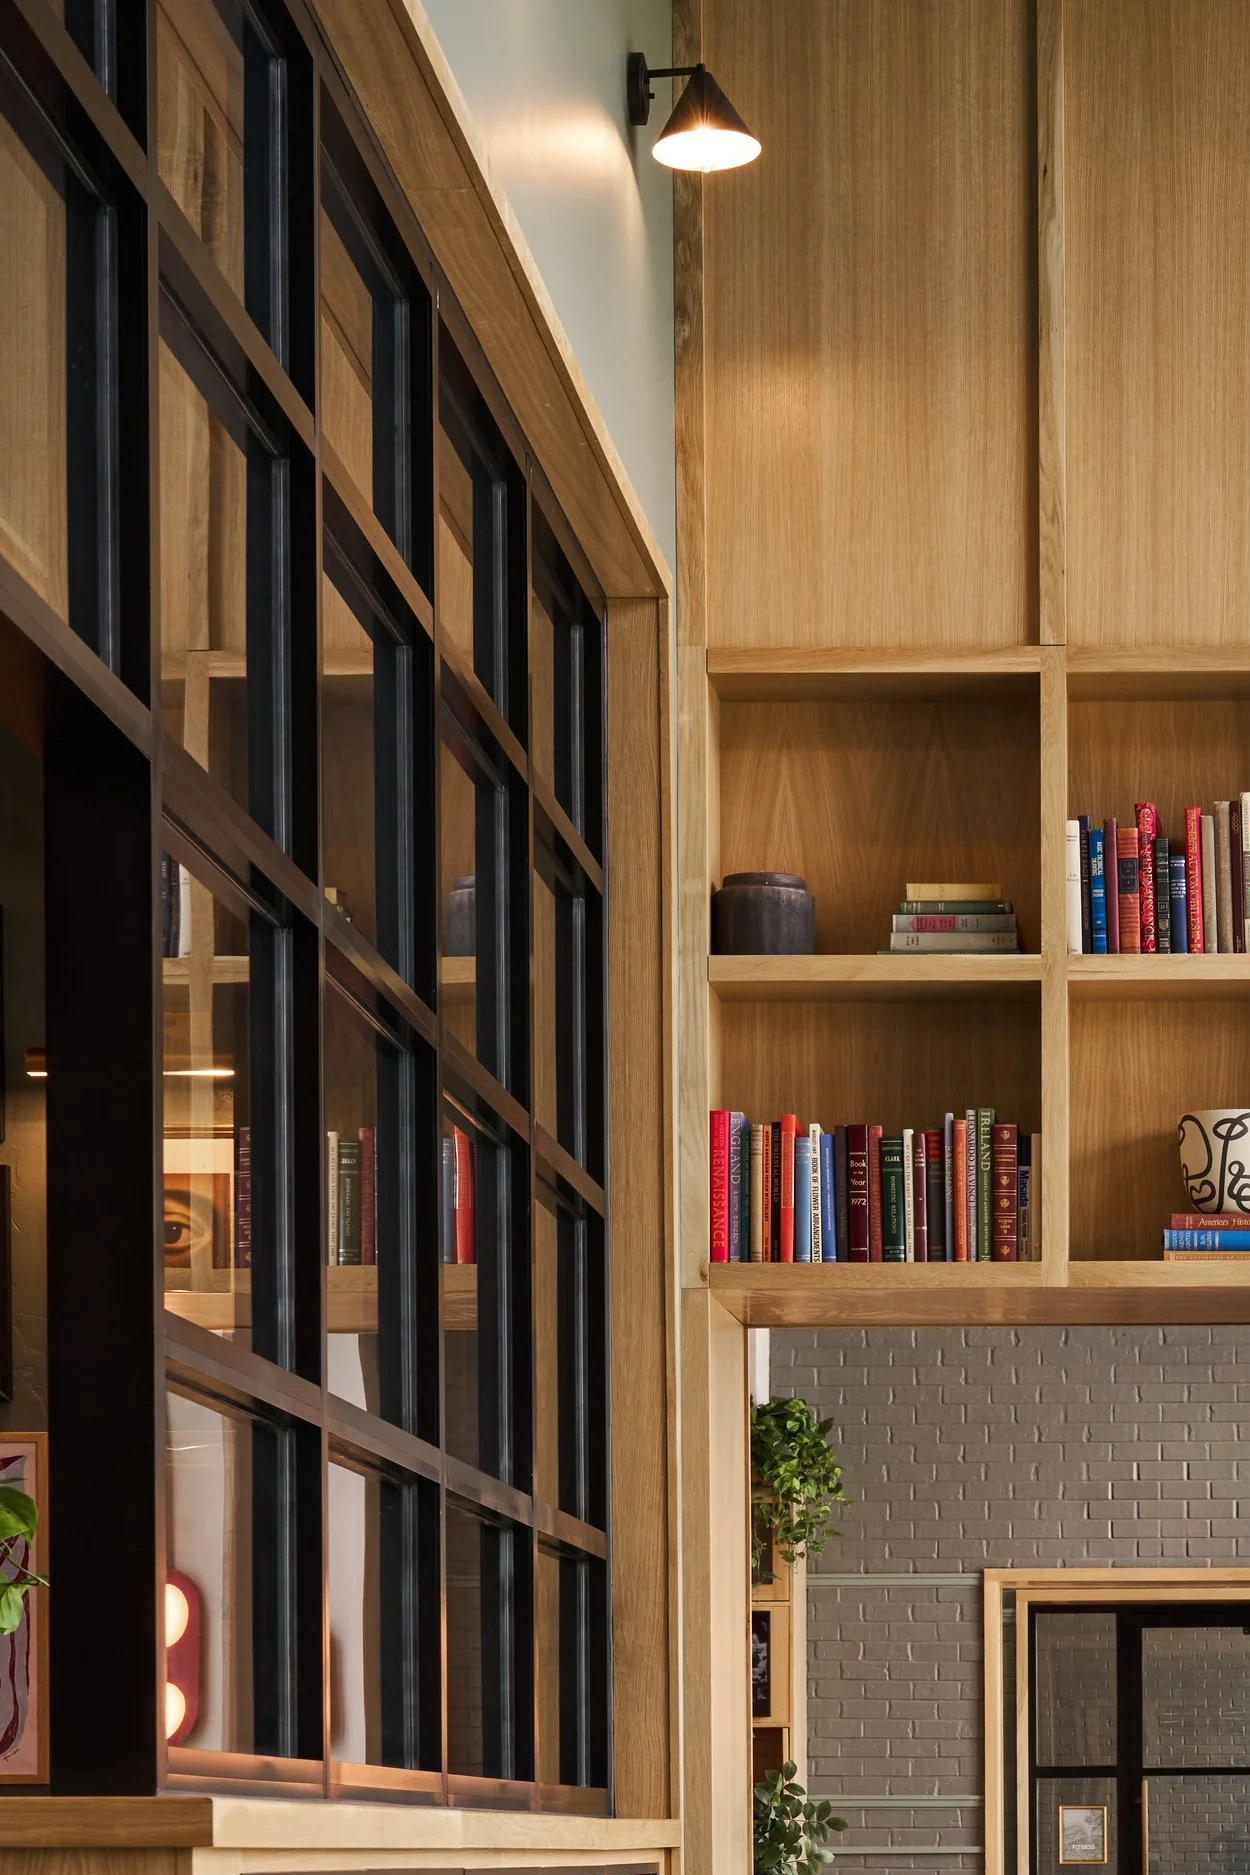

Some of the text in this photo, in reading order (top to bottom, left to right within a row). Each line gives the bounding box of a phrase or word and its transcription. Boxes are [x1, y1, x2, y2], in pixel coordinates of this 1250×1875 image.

[1144, 866, 1154, 941] RENAISSANCE
[1188, 853, 1201, 931] AUTOMOBILES
[730, 1117, 740, 1184] ENGLAND
[968, 1165, 975, 1180] DA
[980, 1111, 990, 1171] IRELAND
[713, 1149, 725, 1247] RENAISSANCE
[1019, 1170, 1029, 1207] Masada
[1198, 1218, 1228, 1226] America's
